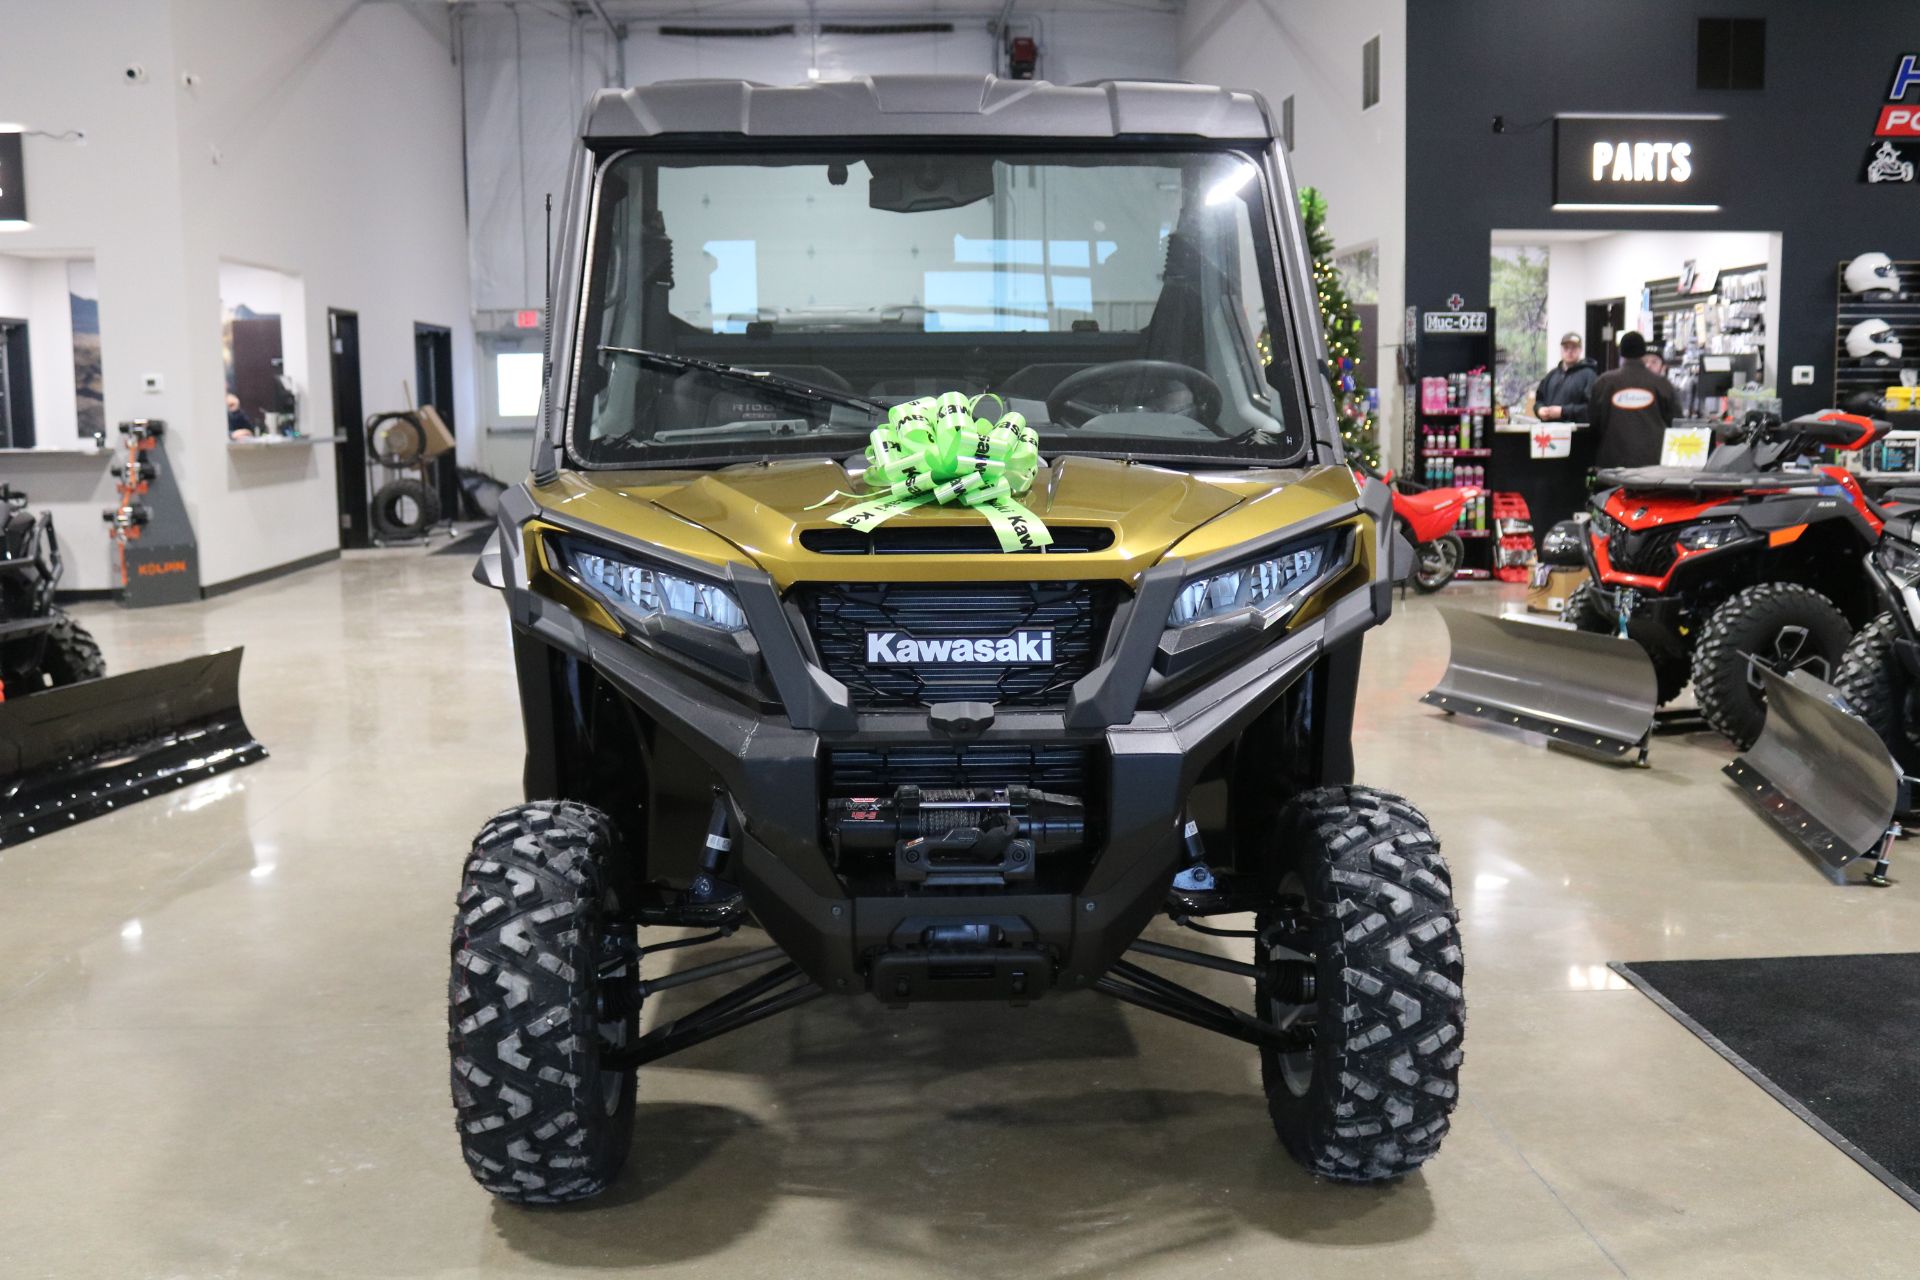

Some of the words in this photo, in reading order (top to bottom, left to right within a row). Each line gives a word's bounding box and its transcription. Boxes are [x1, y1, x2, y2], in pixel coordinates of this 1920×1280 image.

[1592, 142, 1692, 182] PARTS
[1427, 315, 1484, 329] Muc-Off
[867, 632, 1052, 663] Kawasaki
